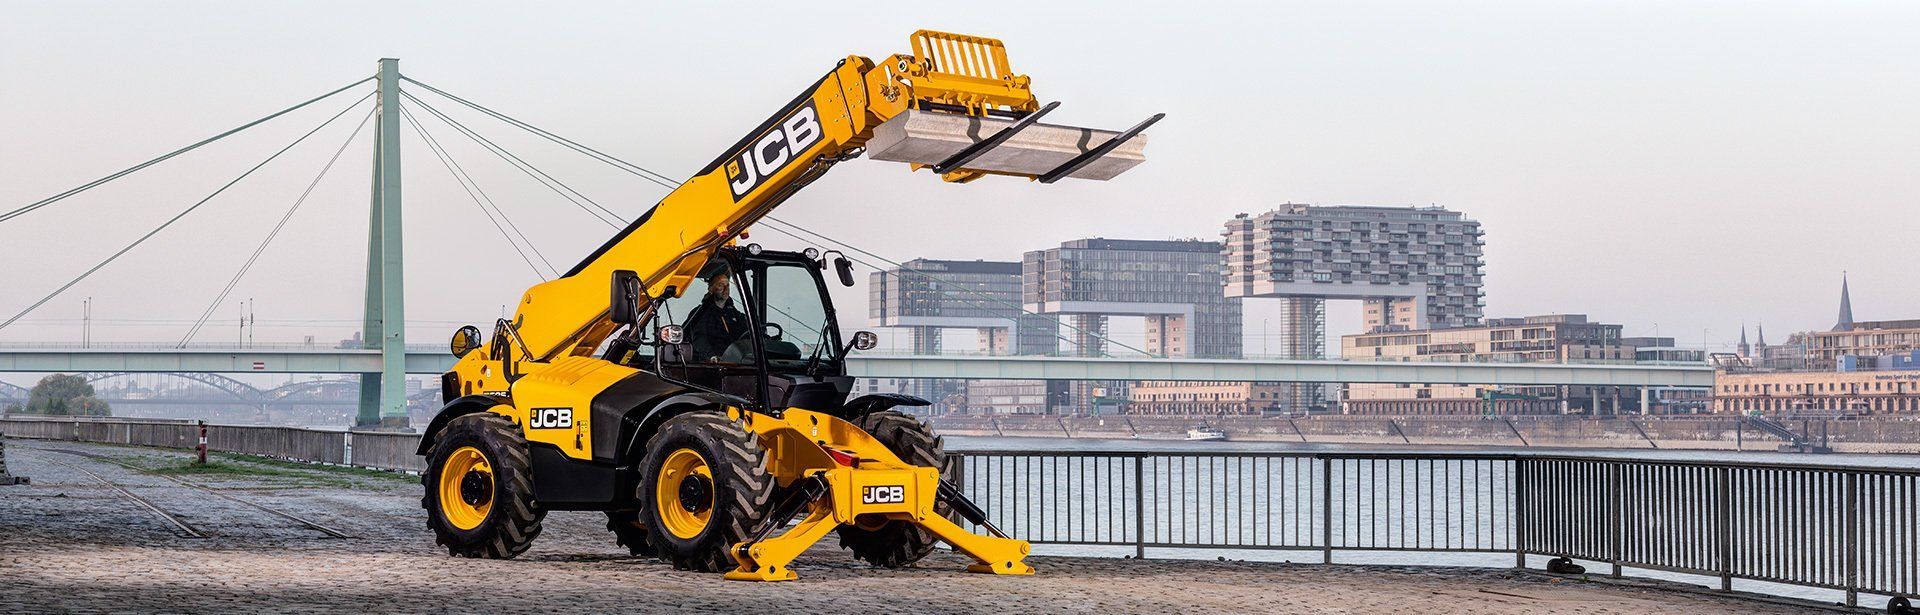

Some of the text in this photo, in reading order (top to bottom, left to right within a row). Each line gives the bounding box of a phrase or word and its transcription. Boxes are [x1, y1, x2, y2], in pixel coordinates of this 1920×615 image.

[732, 106, 820, 195] JCB
[531, 409, 572, 428] JCB
[863, 486, 904, 503] JCB
